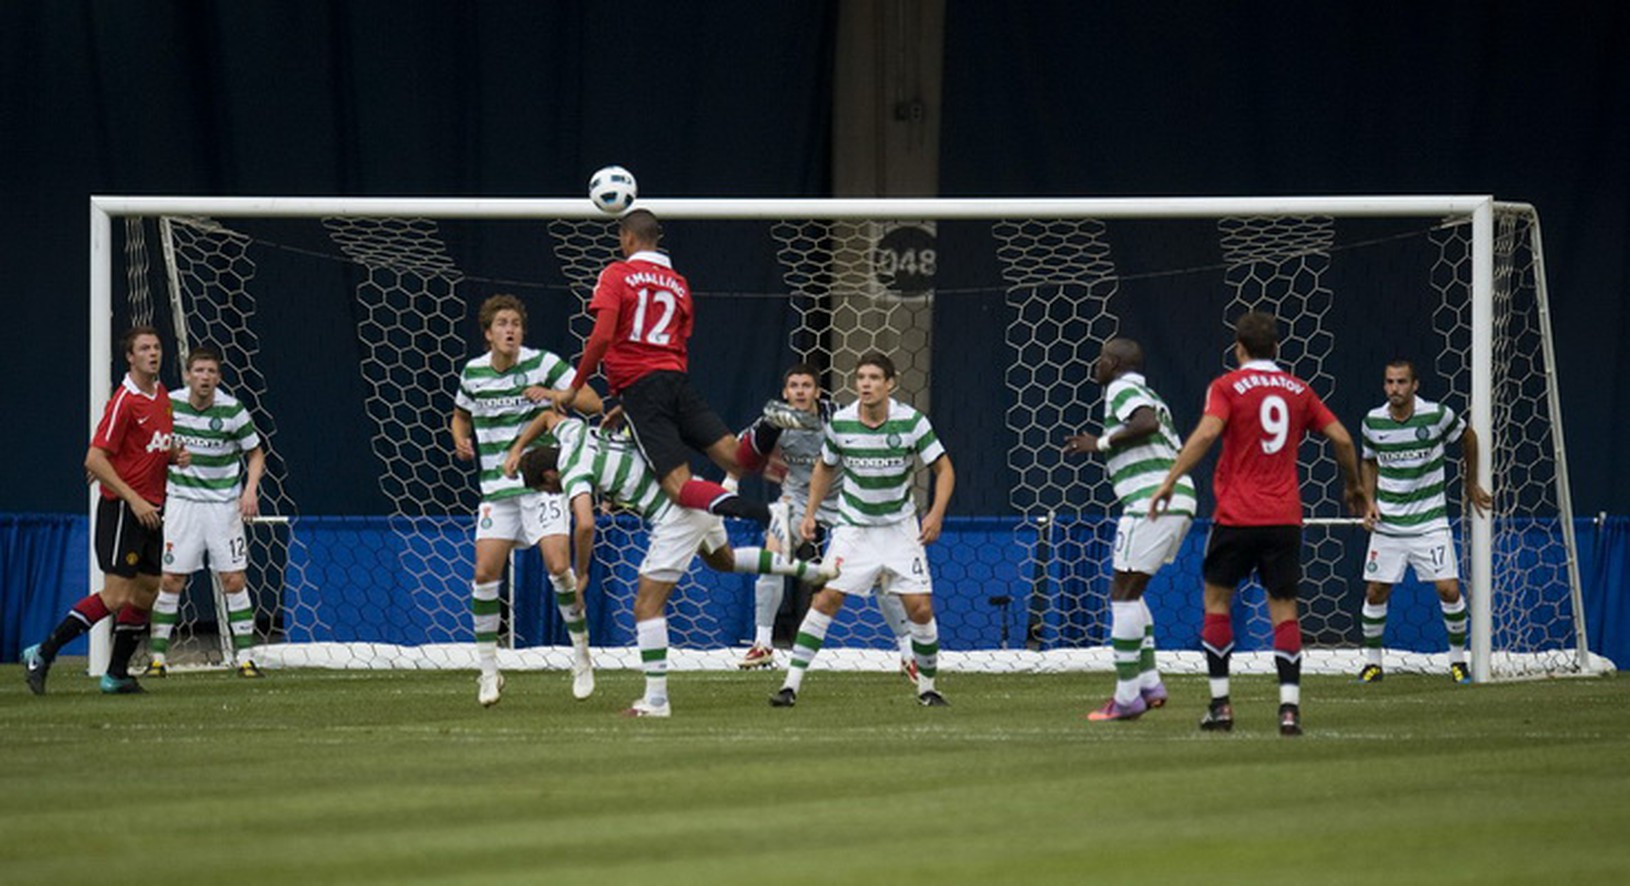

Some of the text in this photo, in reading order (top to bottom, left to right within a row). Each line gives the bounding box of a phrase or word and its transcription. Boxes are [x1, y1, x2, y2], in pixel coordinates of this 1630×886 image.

[629, 287, 676, 346] 12
[1233, 375, 1305, 395] BERBATOV
[1260, 395, 1289, 454] 9
[539, 500, 561, 523] 25
[229, 537, 246, 558] 12
[1430, 545, 1445, 566] 17
[912, 557, 923, 575] 4
